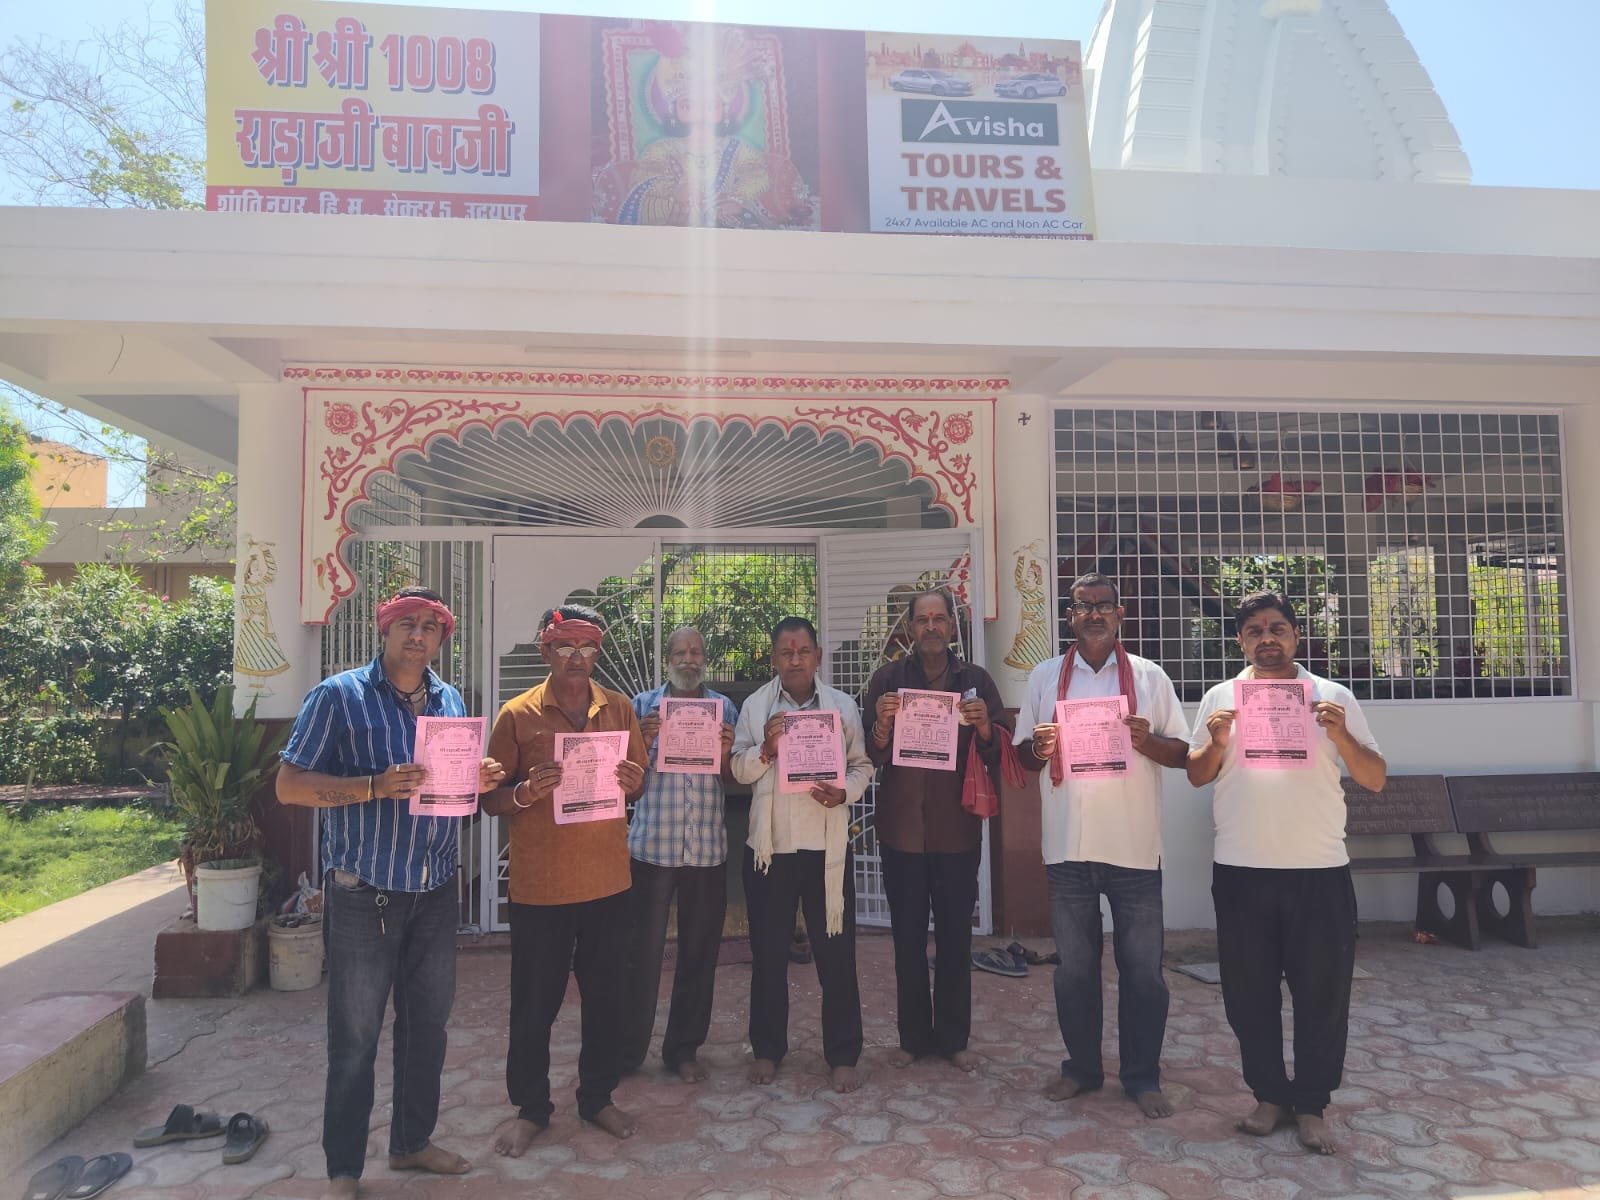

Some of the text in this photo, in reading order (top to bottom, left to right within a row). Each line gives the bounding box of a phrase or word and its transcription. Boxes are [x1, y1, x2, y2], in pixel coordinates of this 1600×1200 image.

[251, 14, 496, 94] श्री श्री 1008
[917, 101, 1044, 141] Avisha
[380, 103, 515, 177] बावजी
[901, 152, 1064, 180] TOURS &
[464, 202, 528, 221] उदयपर
[900, 186, 1067, 213] TRAVELS
[885, 217, 1084, 230] 24x7 Available AC and Non AC Car
